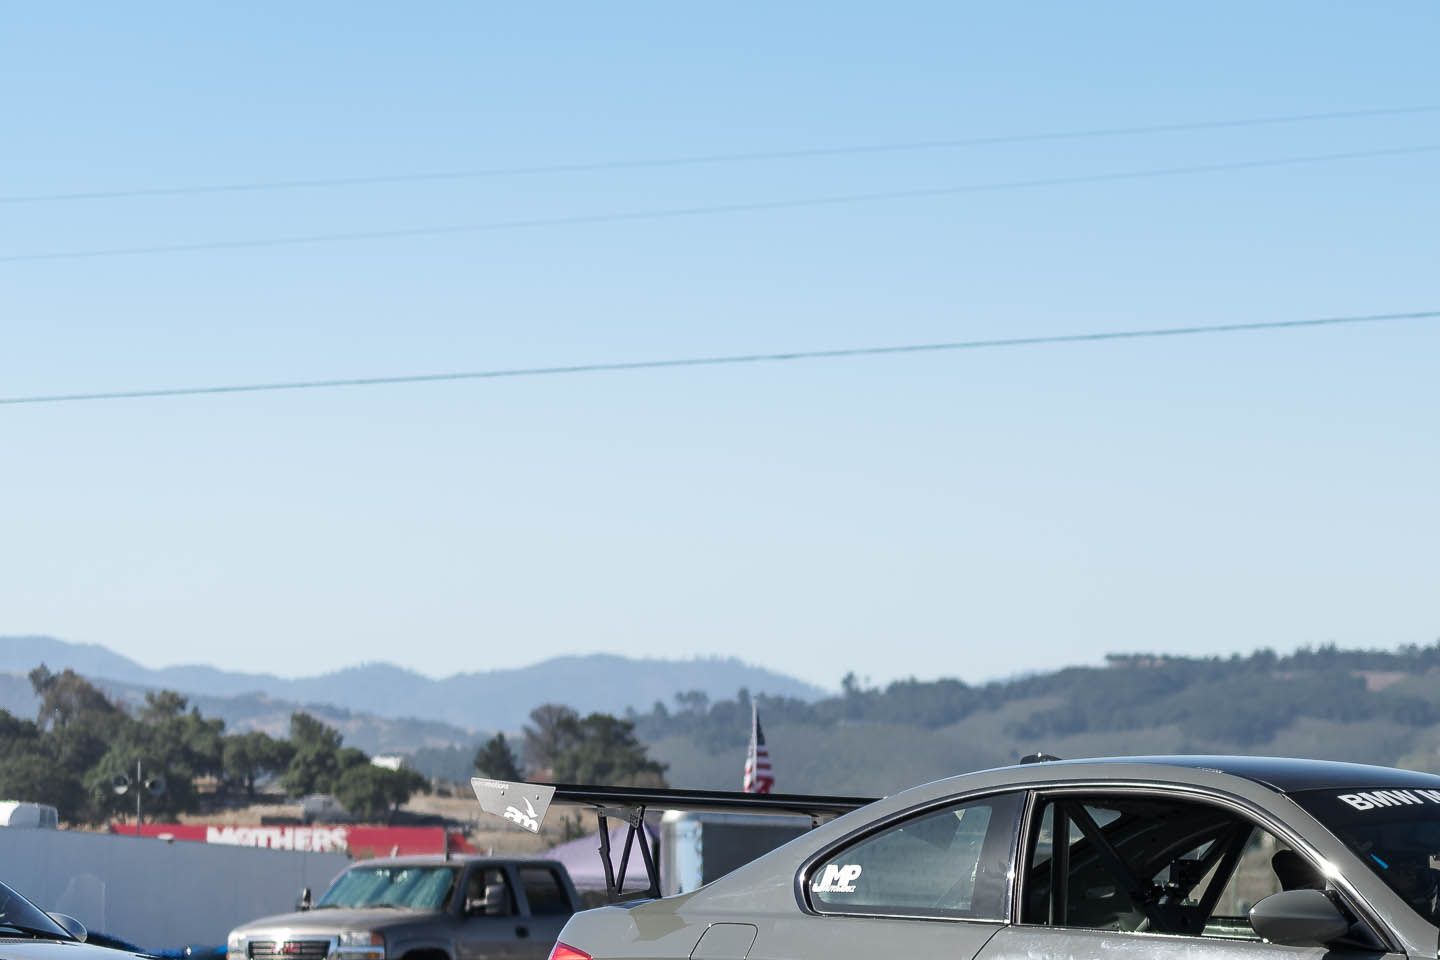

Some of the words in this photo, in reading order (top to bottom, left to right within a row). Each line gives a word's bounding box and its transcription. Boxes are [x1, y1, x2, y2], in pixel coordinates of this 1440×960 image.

[1337, 789, 1425, 811] BMW
[206, 825, 349, 852] MOTHERS
[812, 864, 862, 892] JMP
